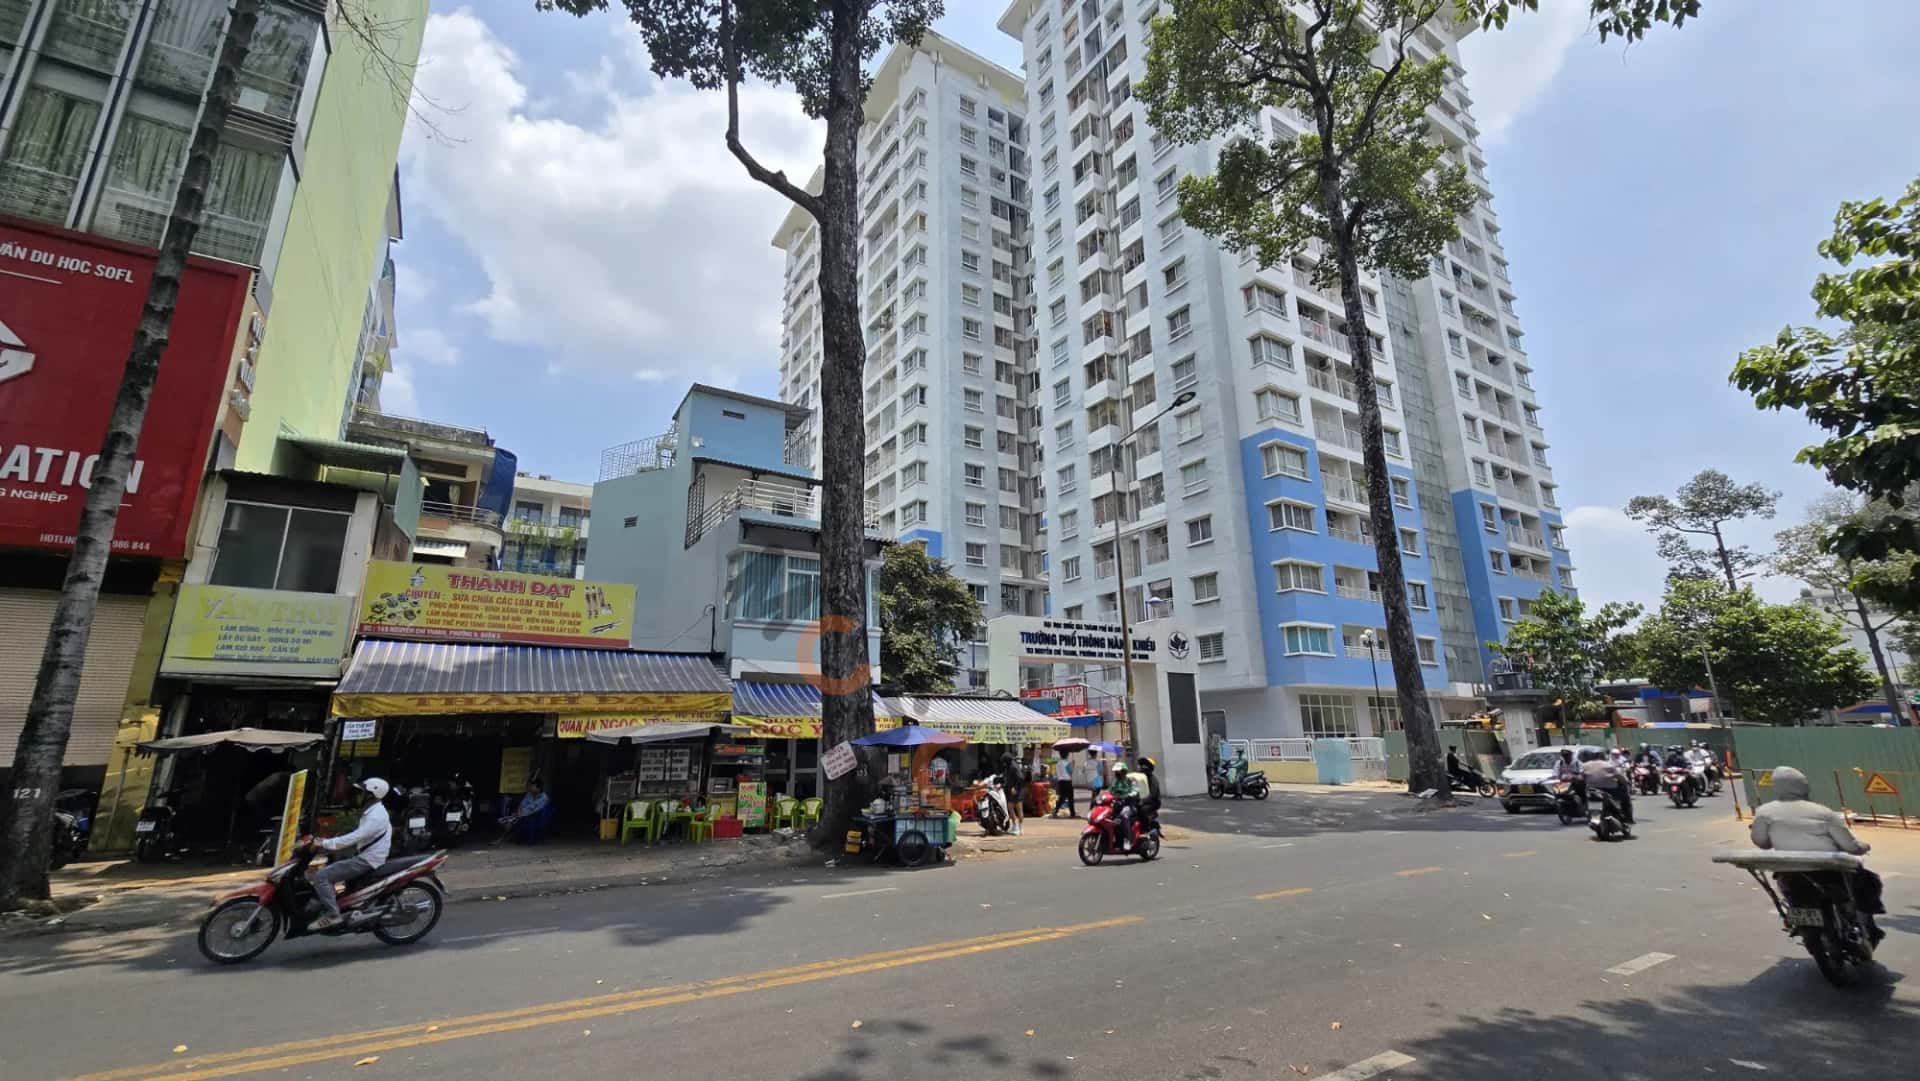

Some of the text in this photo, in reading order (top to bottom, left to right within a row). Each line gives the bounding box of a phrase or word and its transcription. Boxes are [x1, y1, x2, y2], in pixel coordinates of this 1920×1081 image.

[30, 249, 55, 265] DU
[94, 263, 134, 284] SOFL
[10, 488, 69, 503] NGHIỆP
[530, 580, 575, 600] ĐẠT
[1020, 630, 1057, 645] TRƯỜNG
[1078, 633, 1105, 648] THÔNG
